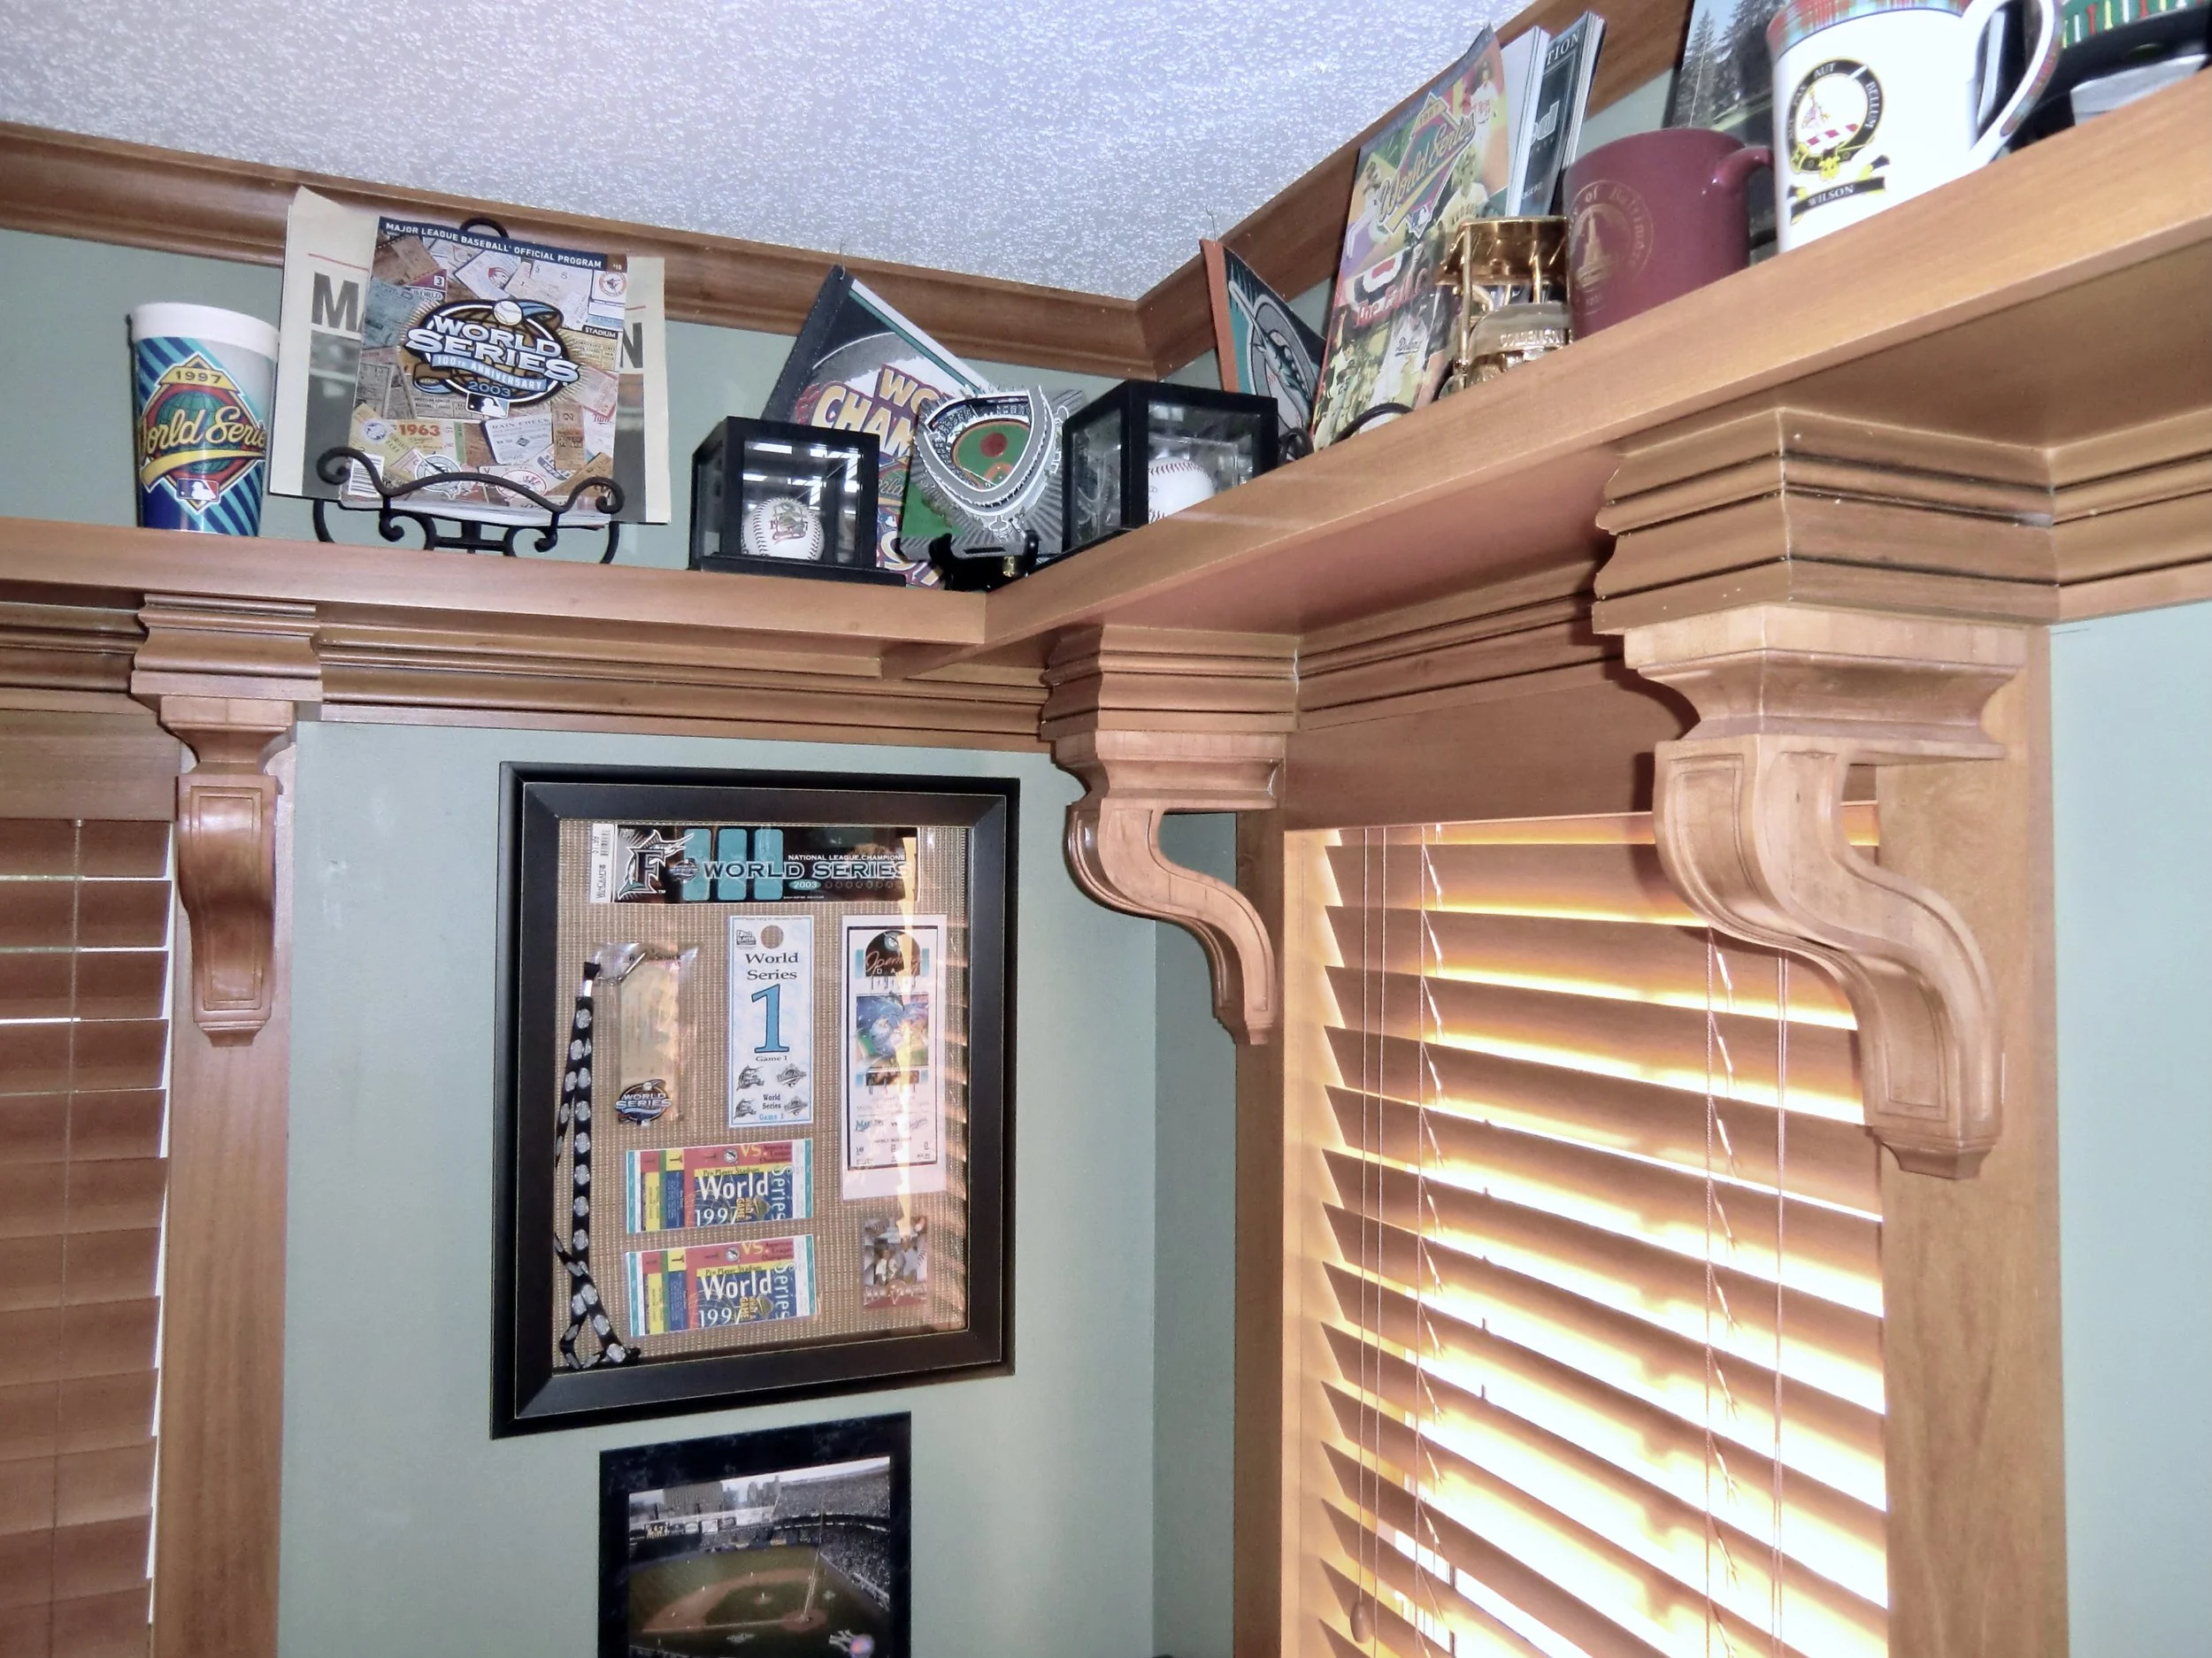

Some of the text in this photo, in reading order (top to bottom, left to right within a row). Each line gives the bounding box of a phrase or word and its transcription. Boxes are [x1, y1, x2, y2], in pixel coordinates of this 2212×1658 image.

[1814, 63, 1836, 77] AUT
[1865, 81, 1880, 128] BELLUM
[1585, 185, 1599, 203] of
[1808, 185, 1855, 207] WILSON
[385, 221, 419, 234] MAJOR
[420, 227, 459, 242] LEAGUE
[513, 246, 556, 261] OFFICIAL
[557, 254, 603, 269] PROGRAM
[427, 314, 562, 357] WORLD
[584, 326, 617, 338] STADIUM
[405, 328, 581, 383] SERIES
[175, 370, 221, 384] 1997
[470, 361, 543, 391] ANNIVERSARY
[468, 381, 511, 397] 2003
[398, 424, 441, 437] 1963
[702, 861, 805, 879] WORLD
[811, 861, 913, 879] SERIES
[745, 952, 799, 964] World
[747, 969, 798, 980] Series
[751, 983, 790, 1054] 1
[615, 1098, 672, 1109] SERIES
[697, 1171, 769, 1201] World
[771, 1165, 795, 1221] Series
[700, 1263, 796, 1319] World Series
